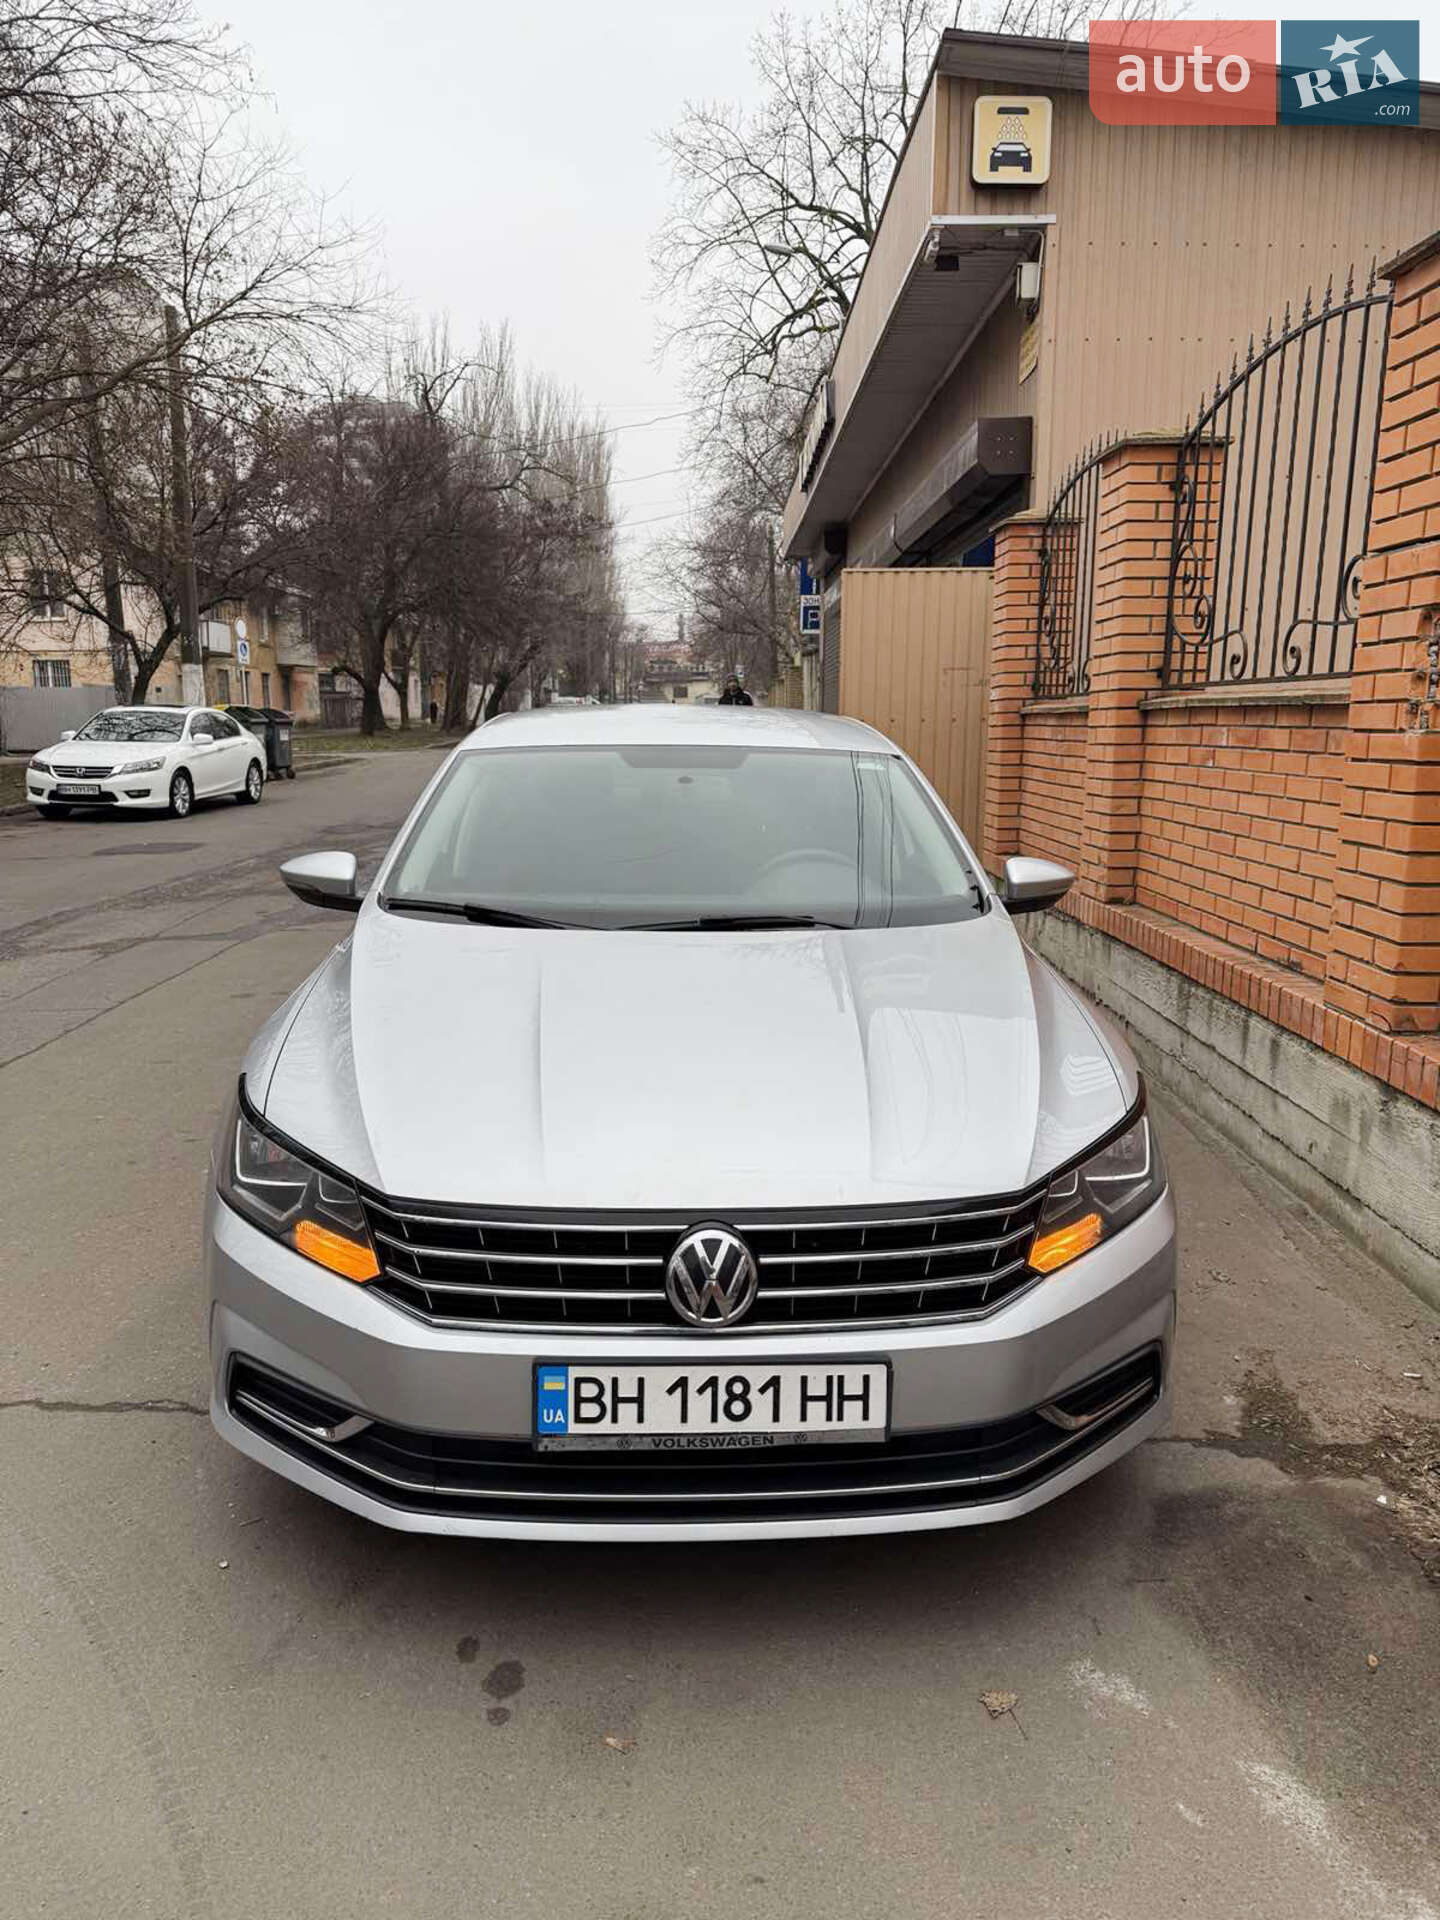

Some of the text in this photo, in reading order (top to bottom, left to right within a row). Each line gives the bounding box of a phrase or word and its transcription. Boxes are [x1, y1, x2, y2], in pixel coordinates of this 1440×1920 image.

[543, 1373, 870, 1424] UA BH 1181 HH
[651, 1434, 775, 1449] VOLKSWAGEN
